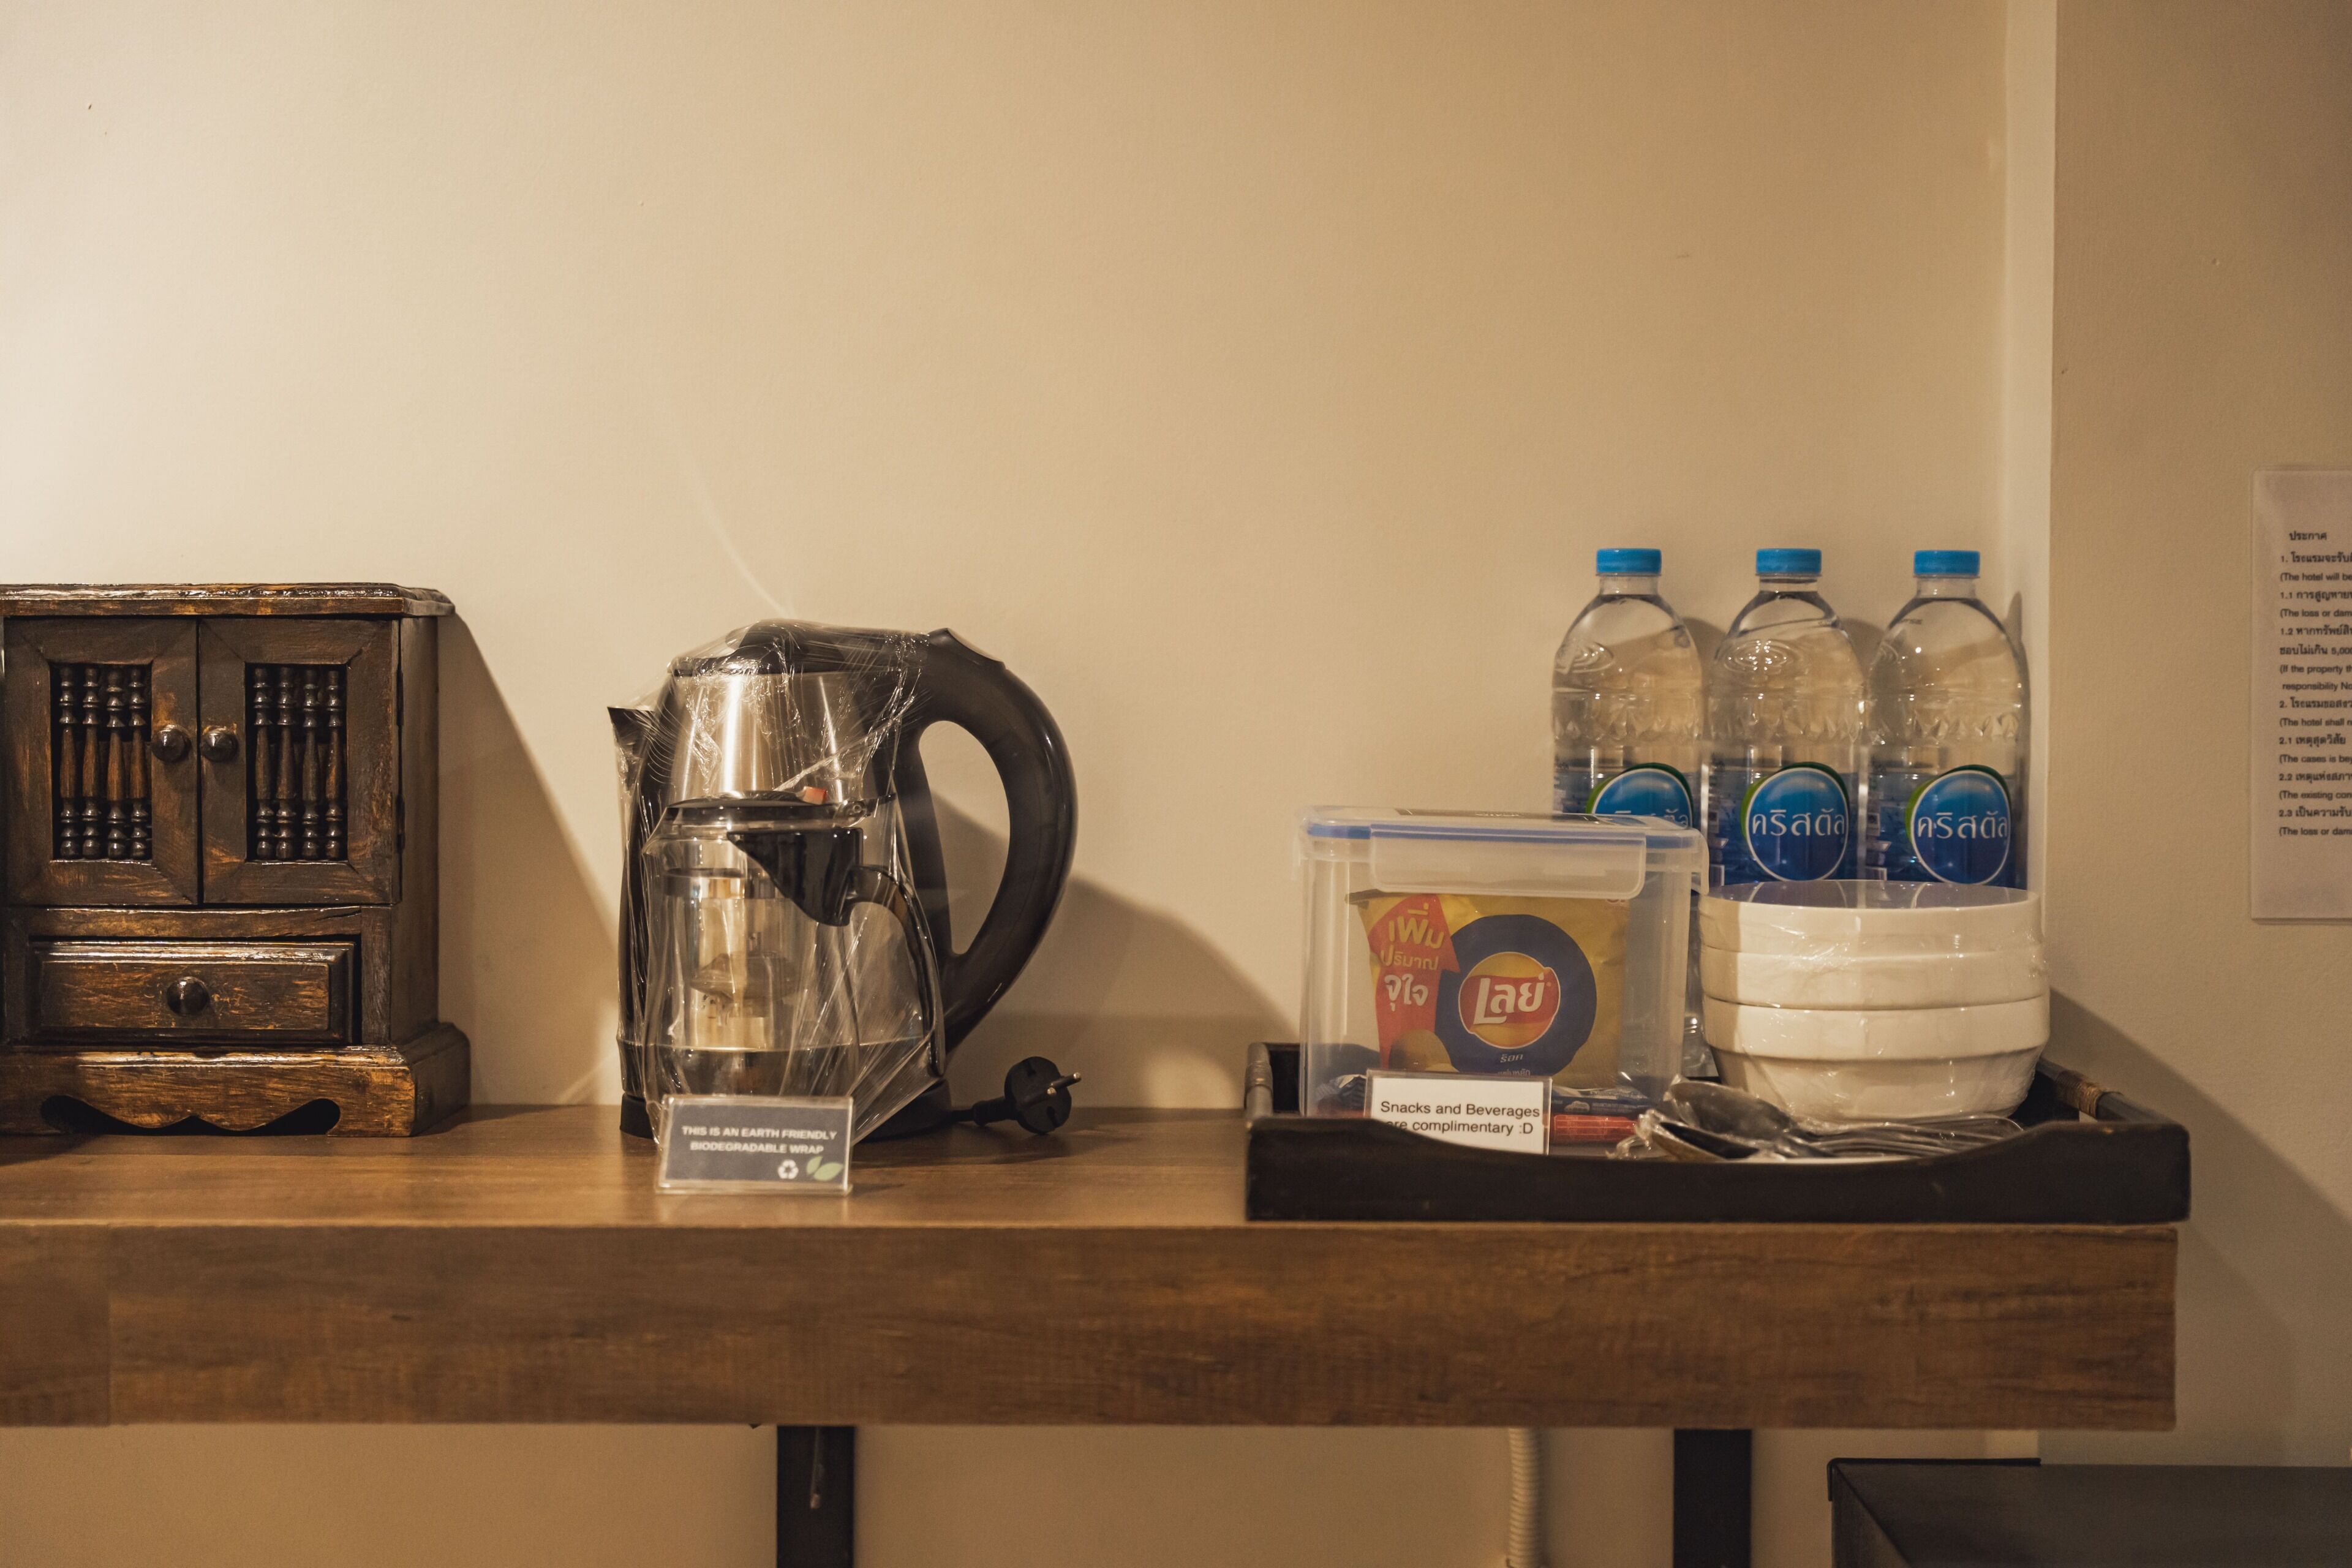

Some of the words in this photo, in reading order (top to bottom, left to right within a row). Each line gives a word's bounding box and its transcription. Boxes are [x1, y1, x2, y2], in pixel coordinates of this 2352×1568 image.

[2289, 530, 2328, 541] ประกาศ
[2280, 572, 2299, 581] (The
[2280, 609, 2299, 618] (The
[2307, 665, 2343, 674] property
[2283, 682, 2338, 692] responsibility
[2280, 718, 2299, 727] (The
[2280, 754, 2299, 764] (The
[2280, 790, 2299, 800] (The
[2301, 791, 2333, 801] existing
[1752, 809, 1845, 837] คริสตัล
[1918, 811, 2008, 839] คริสตัล
[2279, 826, 2299, 837] (The
[1389, 903, 1444, 949] เพิ่ม
[1380, 944, 1439, 970] ปริมาณ
[1384, 973, 1429, 1011] จุใจ
[1473, 972, 1545, 1025] เลย์
[1381, 1101, 1431, 1114] Snacks
[1436, 1103, 1461, 1114] and
[1466, 1103, 1540, 1120] Beverages
[682, 1126, 707, 1136] THIS
[709, 1126, 721, 1136] IS
[723, 1126, 740, 1137] AN
[741, 1128, 780, 1138] EARTH
[782, 1129, 837, 1140] FRIENDLY
[1412, 1120, 1514, 1136] complimentary
[1520, 1122, 1534, 1134] :D
[690, 1140, 787, 1153] BIODEGRADABLE
[789, 1144, 824, 1154] WRAP
